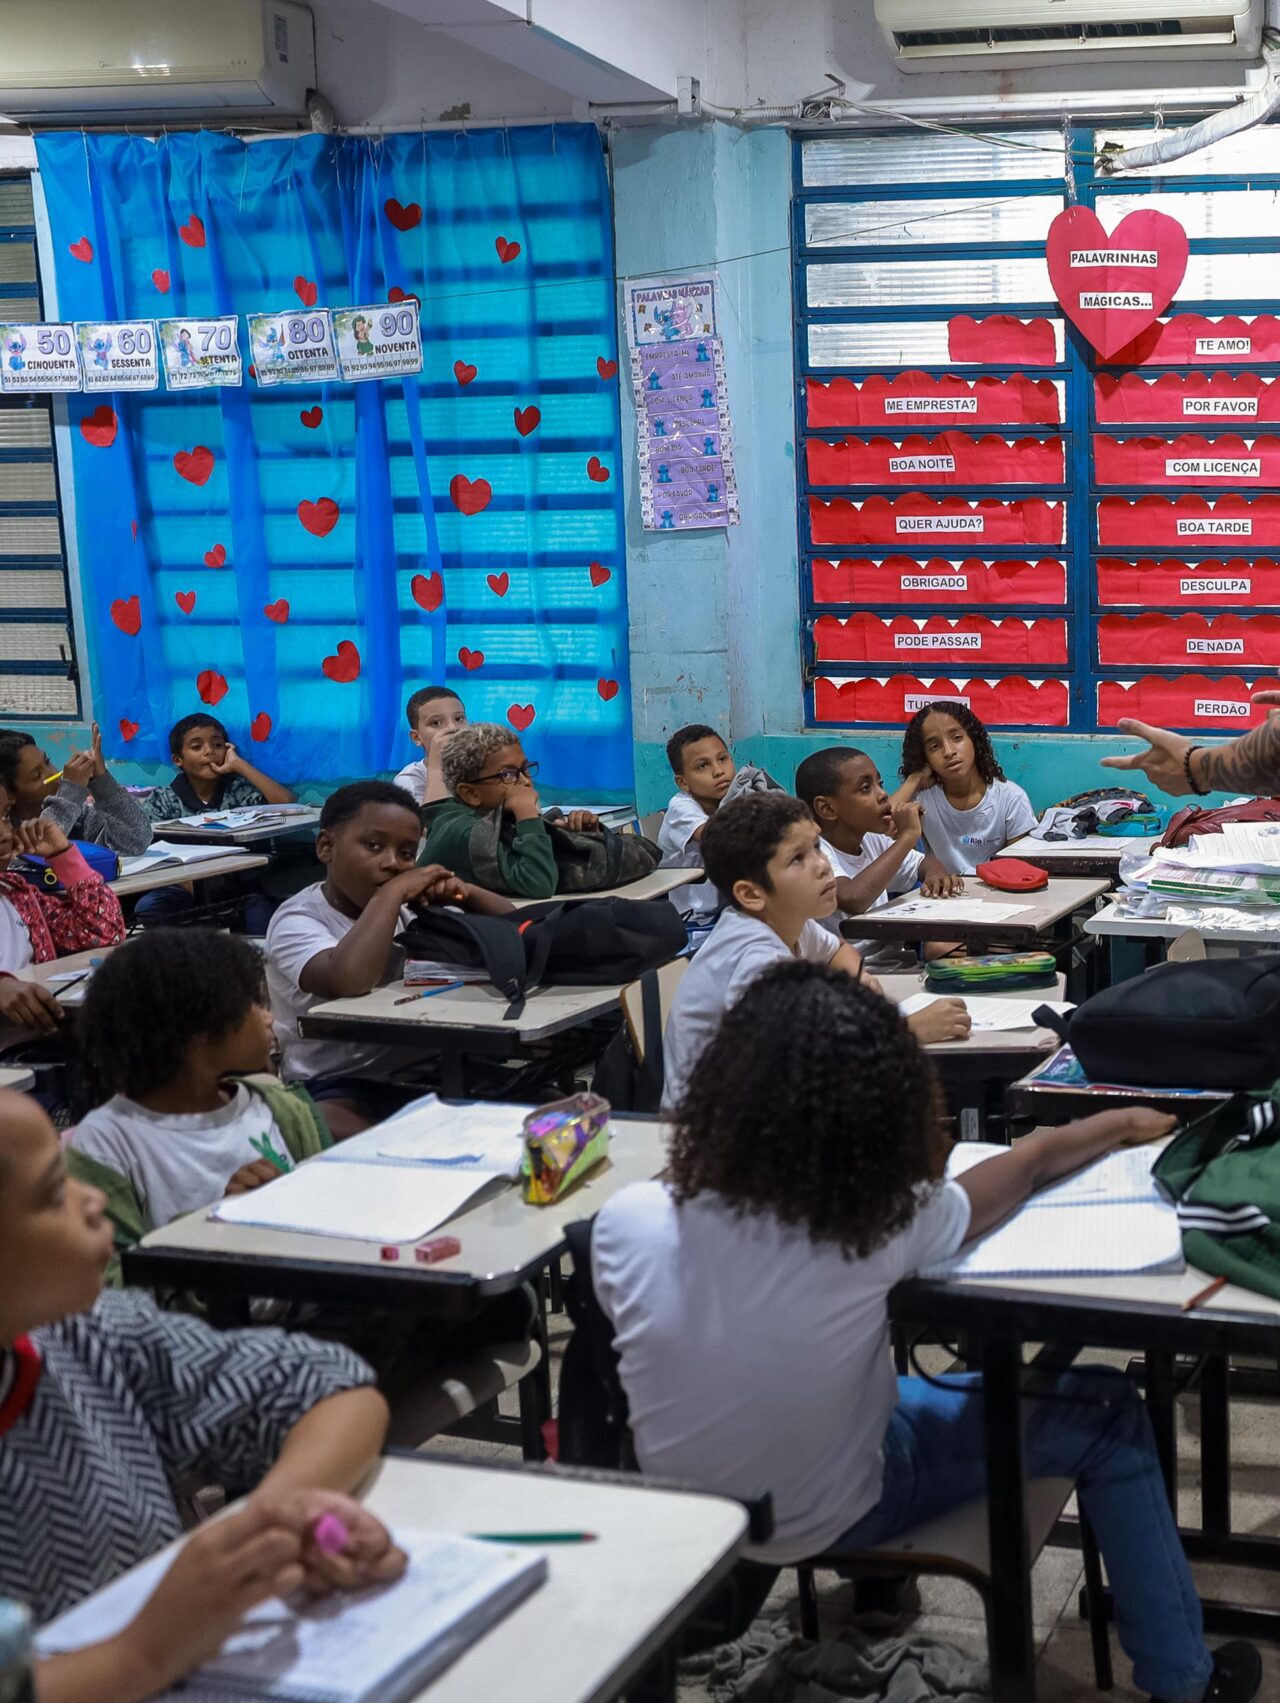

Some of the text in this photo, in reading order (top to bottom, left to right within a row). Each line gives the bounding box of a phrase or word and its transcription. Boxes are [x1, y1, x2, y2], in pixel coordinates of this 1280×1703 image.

[1071, 253, 1157, 265] PALAVRINHAS
[1084, 295, 1152, 307] MÁGICAS...
[380, 311, 413, 337] 90
[288, 317, 325, 344] 80
[38, 330, 70, 355] 50
[118, 328, 151, 355] 60
[198, 325, 231, 351] 70
[375, 341, 417, 354] NOVENTA
[1199, 340, 1249, 350] TE AMO!
[288, 348, 328, 360] OITENTA
[28, 360, 75, 370] CINQUENTA
[112, 358, 150, 368] SESSENTA
[200, 355, 237, 365] SETENTA
[887, 399, 975, 410] ME EMPRESTA?
[1185, 401, 1256, 411] POR FAVOR
[892, 458, 953, 470] BOA NOITE
[1173, 462, 1257, 475] COM LICENÇA
[899, 519, 982, 529] QUER AJUDA?
[1179, 523, 1249, 532] BOA TARDE
[903, 578, 964, 587] OBRIGADO
[1182, 581, 1247, 591] DESCULPA
[898, 637, 978, 646] PODE PASSAR
[1189, 641, 1242, 651] DE NADA
[1197, 703, 1247, 715] PERDÃO
